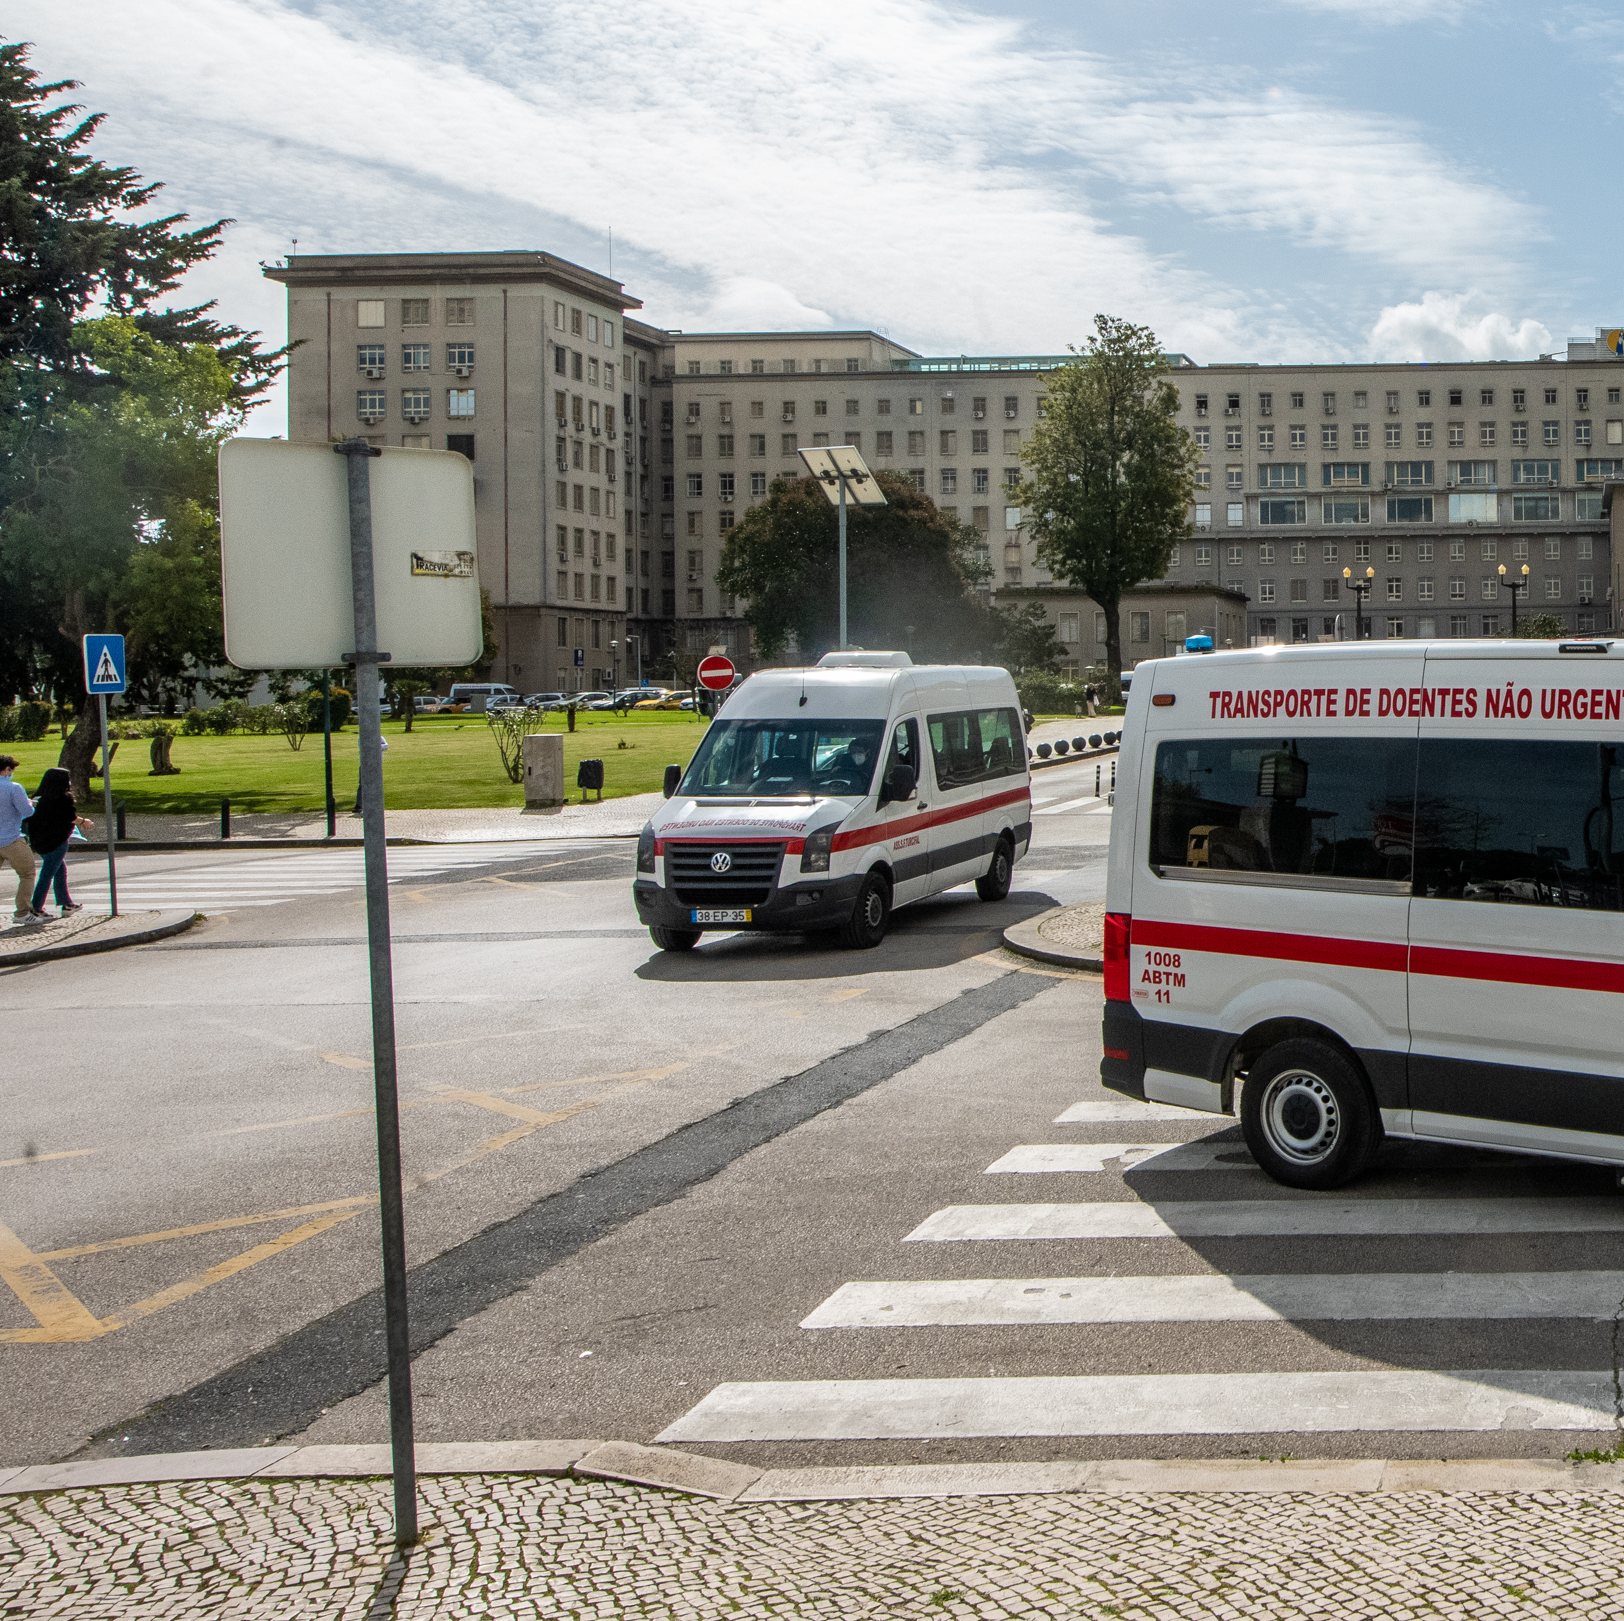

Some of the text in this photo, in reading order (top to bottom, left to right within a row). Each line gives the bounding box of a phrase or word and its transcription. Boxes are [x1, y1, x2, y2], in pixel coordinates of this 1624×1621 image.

[1209, 688, 1339, 719] TRANSPORTE
[1344, 688, 1372, 717] DE
[1377, 687, 1478, 718] DOENTES
[1484, 681, 1533, 719] NÃO
[1145, 951, 1181, 968] 1008
[1141, 969, 1186, 988] ABTM
[1155, 989, 1170, 1004] 11
